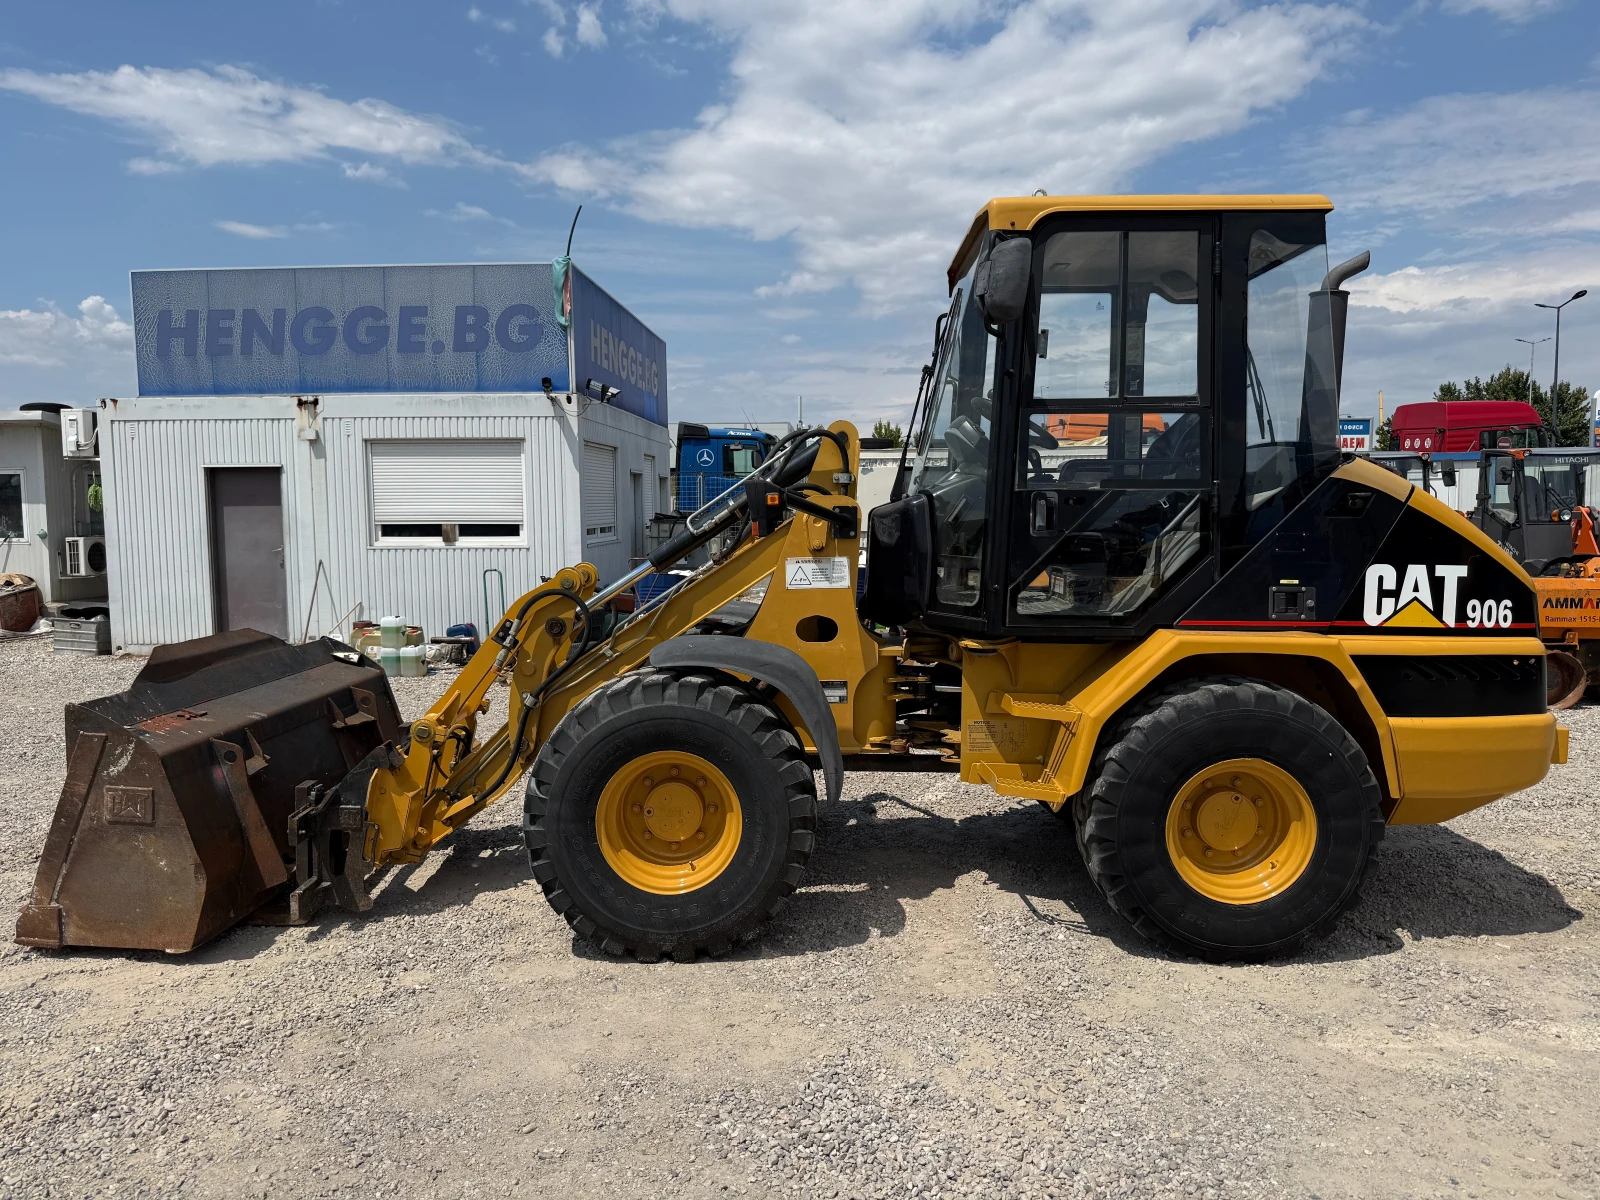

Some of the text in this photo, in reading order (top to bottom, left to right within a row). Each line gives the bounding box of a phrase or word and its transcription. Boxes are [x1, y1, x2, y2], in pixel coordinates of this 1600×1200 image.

[156, 303, 544, 357] HENGGE.BG
[590, 318, 659, 397] HENGGE.BG
[1363, 563, 1513, 628] CAT 906
